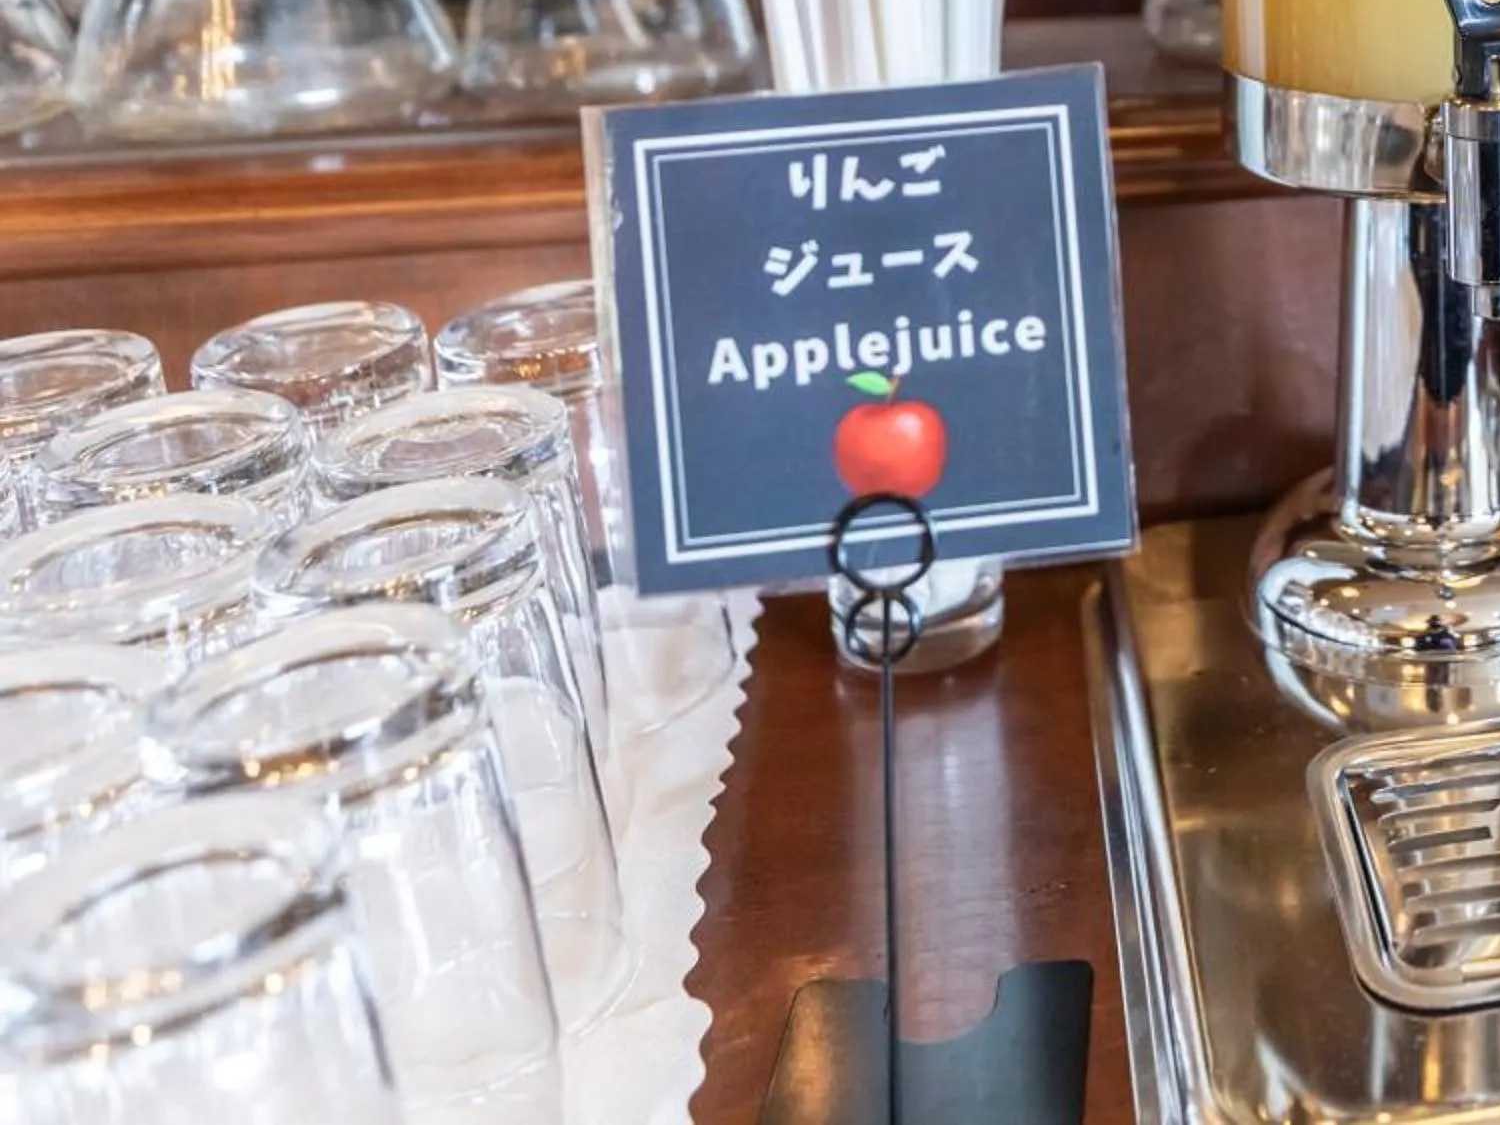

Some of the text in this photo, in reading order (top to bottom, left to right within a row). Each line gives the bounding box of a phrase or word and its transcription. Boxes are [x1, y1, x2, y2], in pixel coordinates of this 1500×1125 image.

[788, 145, 946, 209] りんご
[763, 231, 978, 296] ジュース
[708, 310, 1046, 389] Applejuice
